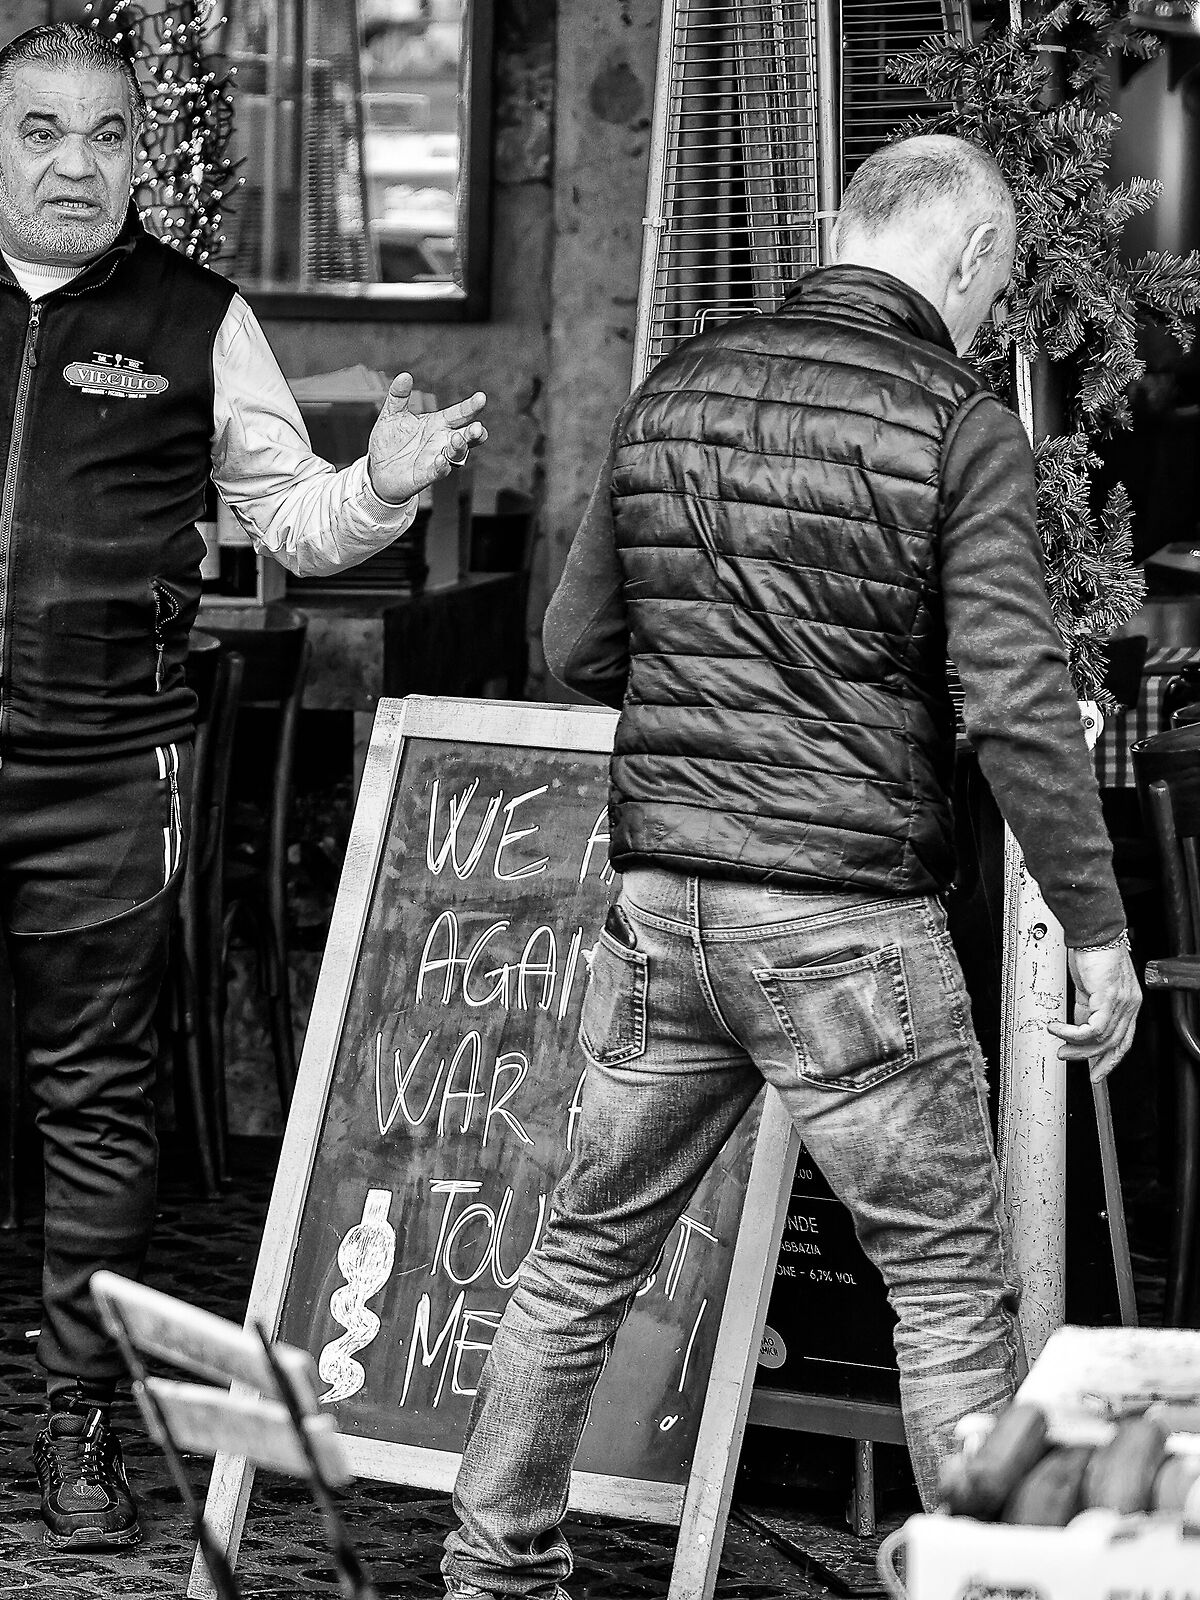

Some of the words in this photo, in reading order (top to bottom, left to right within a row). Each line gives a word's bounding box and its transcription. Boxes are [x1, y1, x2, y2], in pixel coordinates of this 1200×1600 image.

[77, 368, 157, 389] VIRGILIO
[426, 776, 549, 880] WE
[416, 910, 583, 1021] AGAI
[375, 1029, 536, 1147] WAR
[776, 1264, 797, 1277] ONE
[835, 1272, 857, 1285] VOL
[784, 1215, 819, 1233] NDE
[400, 1291, 503, 1408] ME
